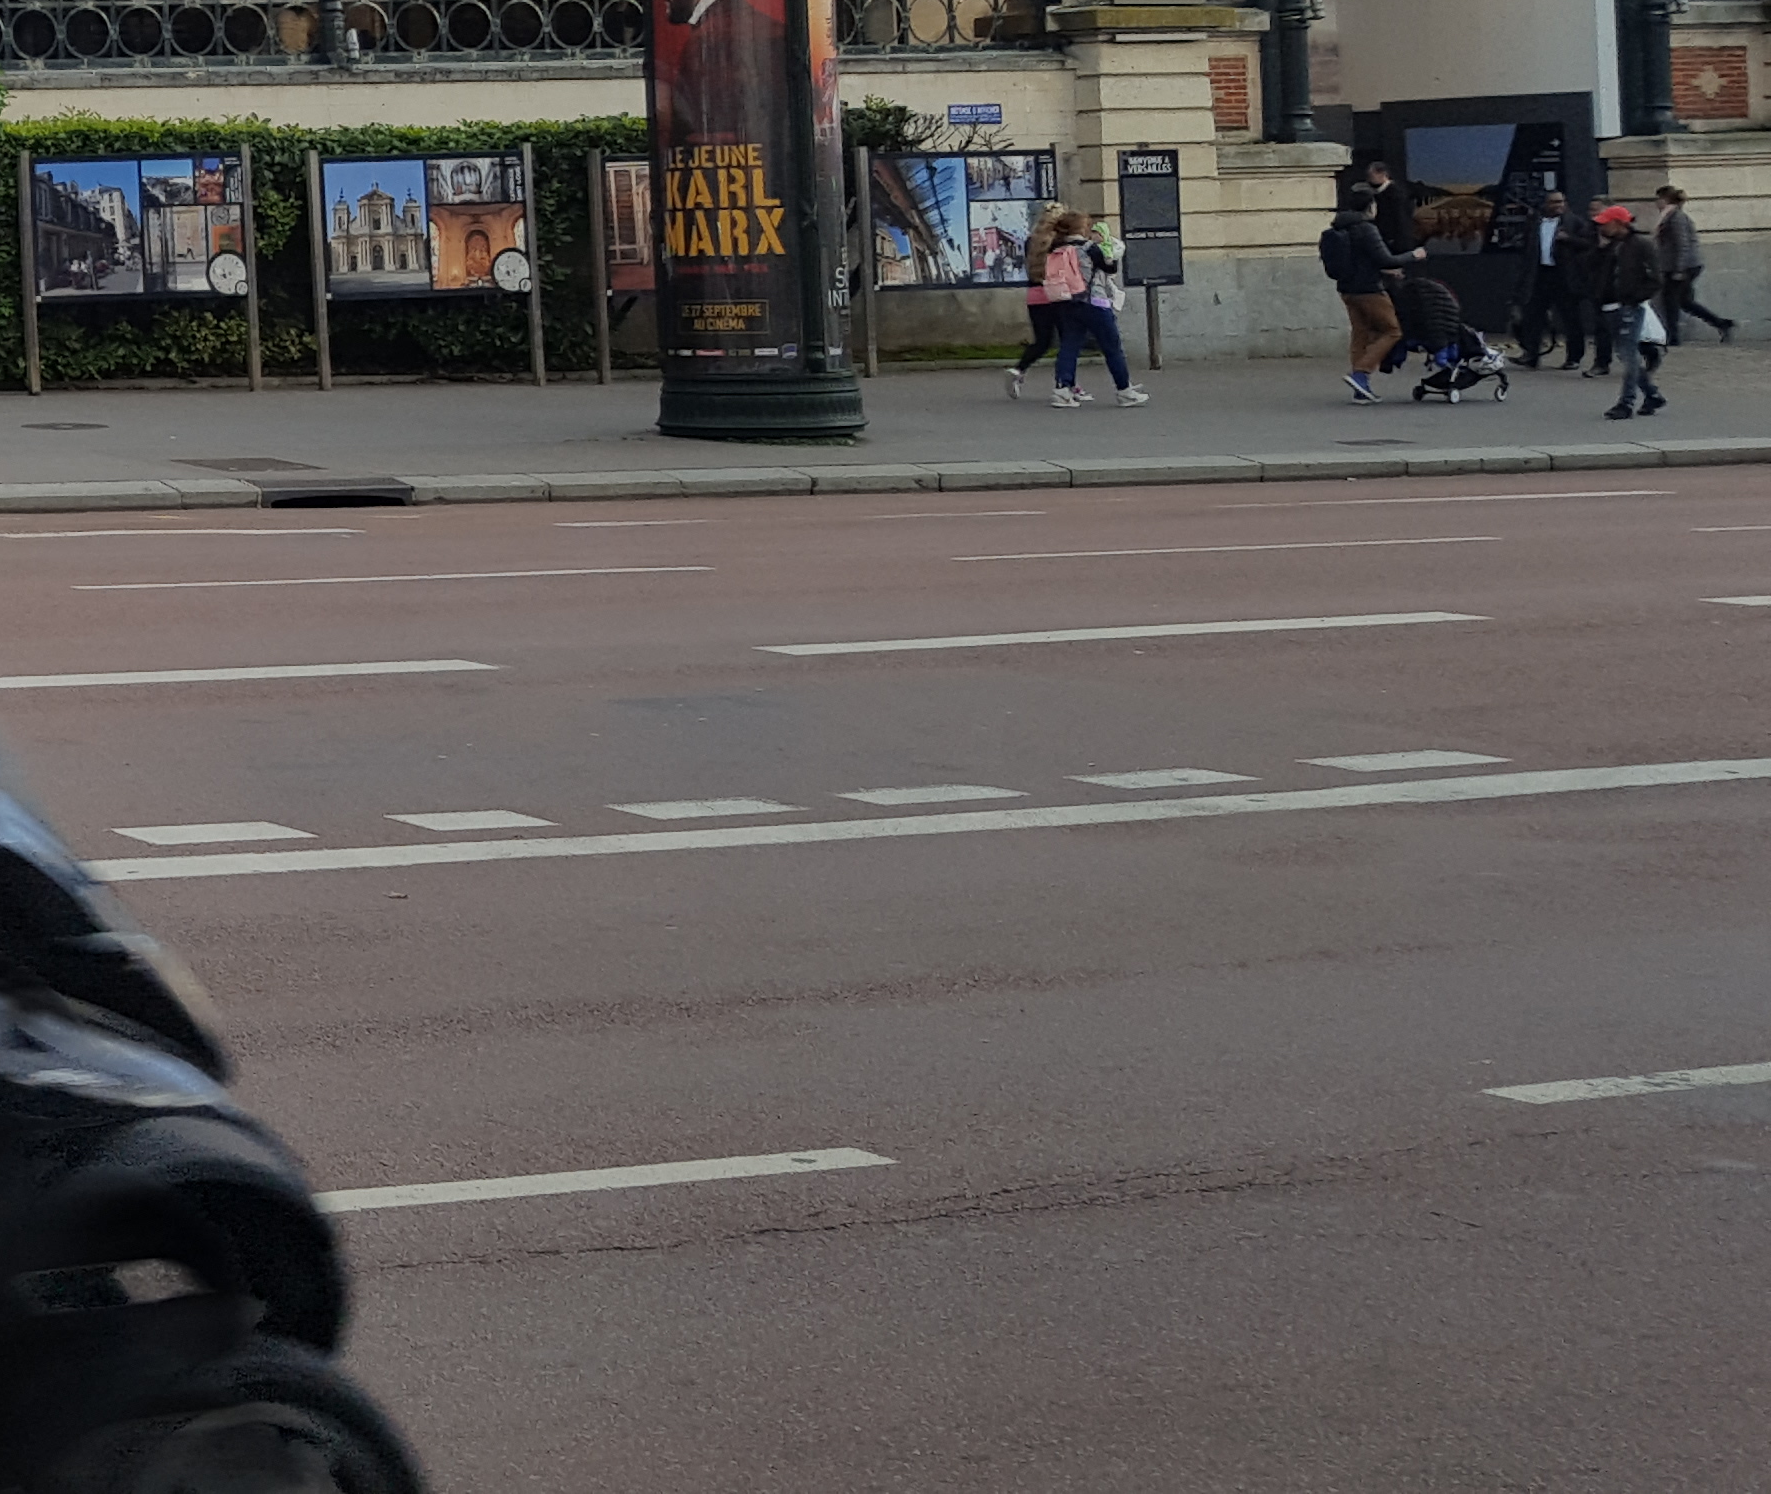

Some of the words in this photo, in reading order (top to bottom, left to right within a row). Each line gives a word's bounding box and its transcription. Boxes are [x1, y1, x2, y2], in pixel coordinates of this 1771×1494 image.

[667, 146, 685, 168] LE
[688, 144, 763, 168] JEUNE
[665, 168, 781, 209] KARL
[664, 208, 786, 256] MARX
[702, 304, 762, 317] SEPTEMBRE
